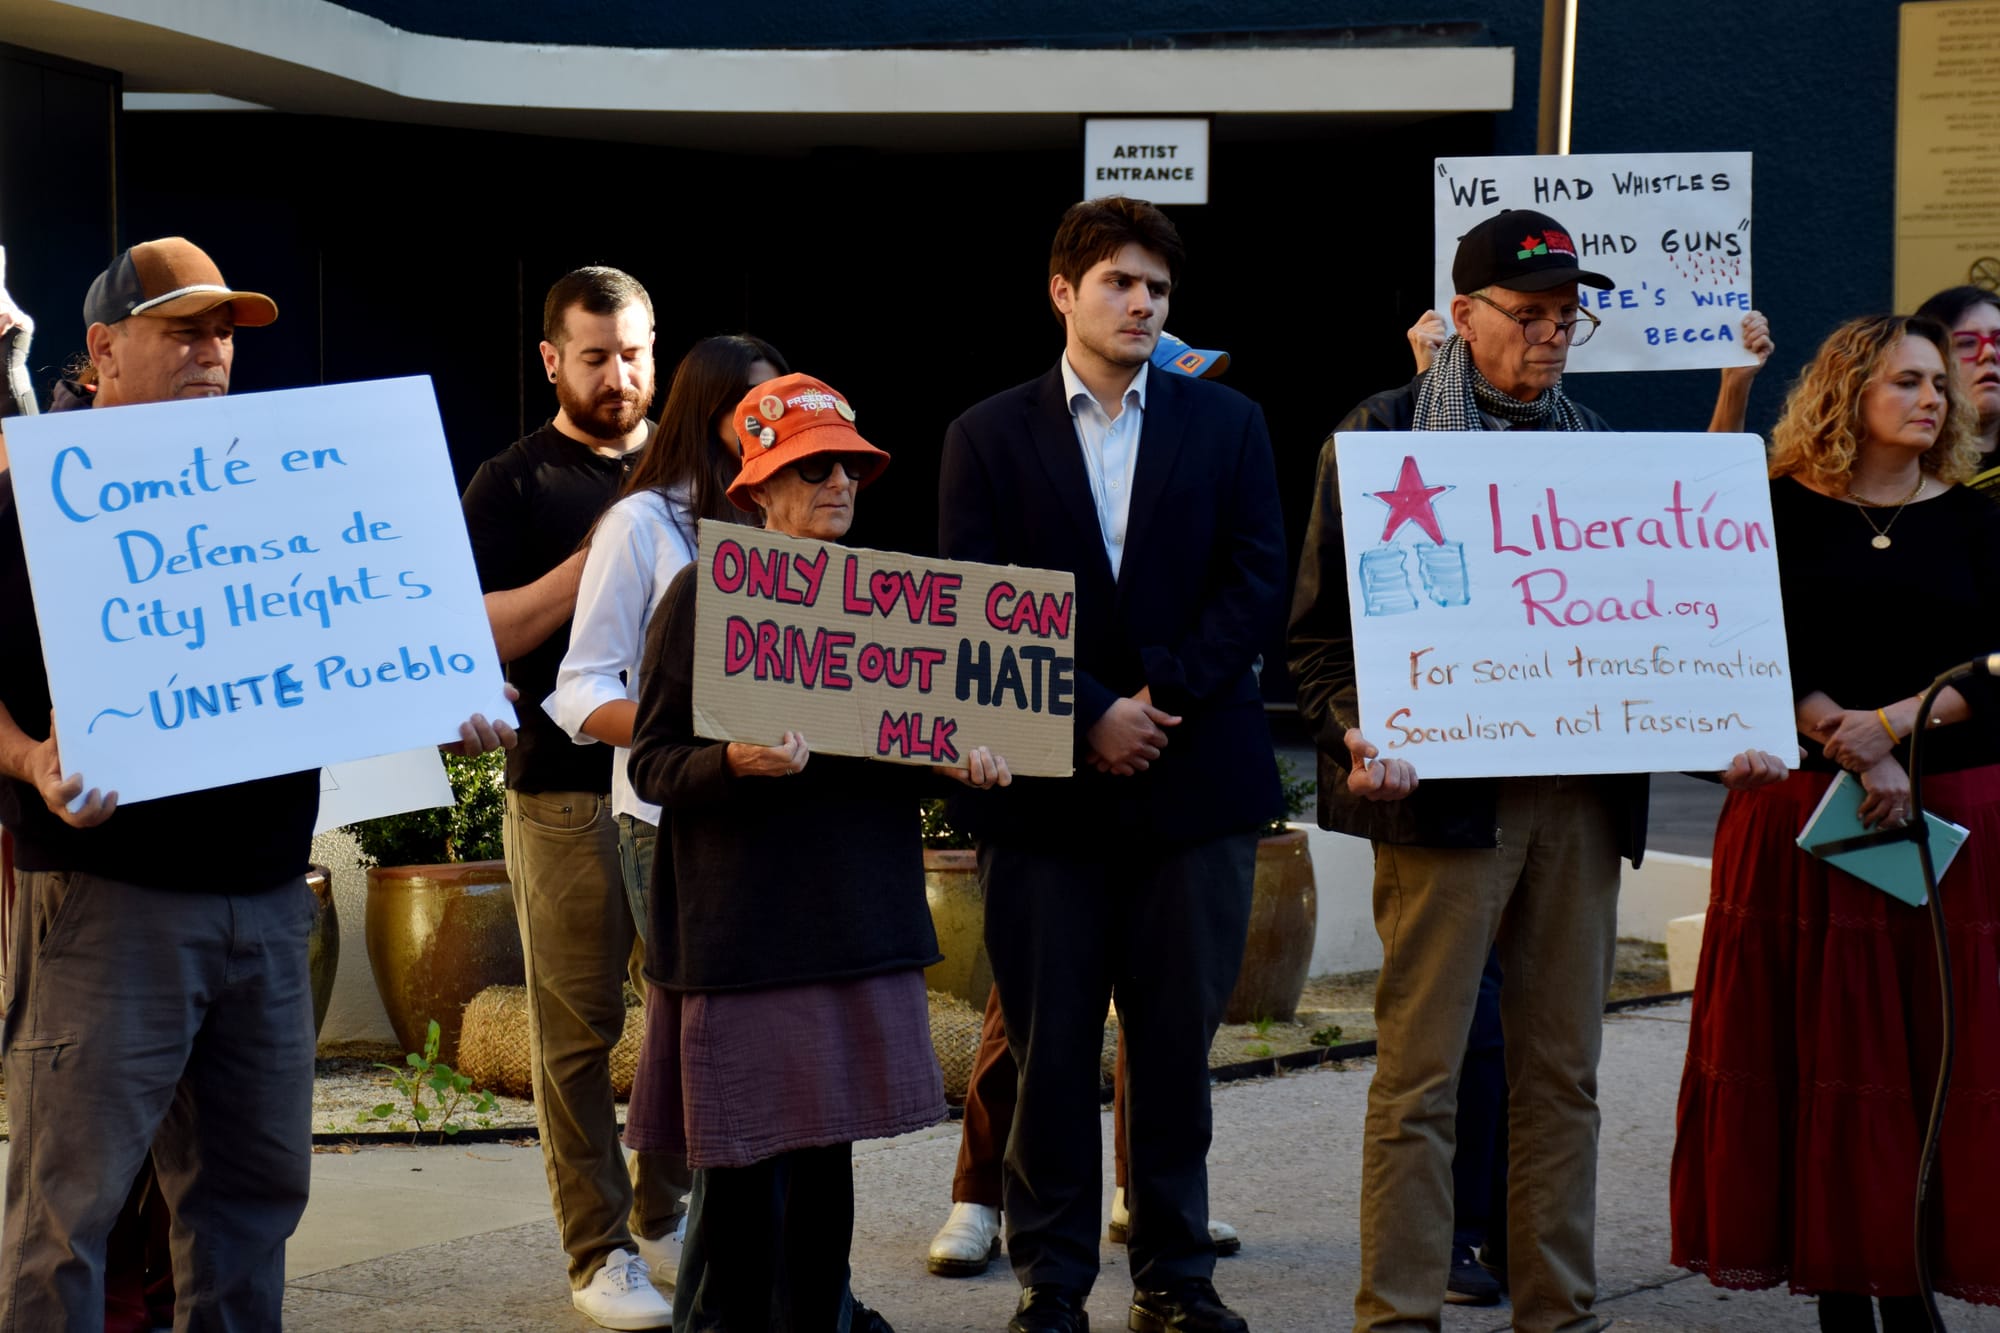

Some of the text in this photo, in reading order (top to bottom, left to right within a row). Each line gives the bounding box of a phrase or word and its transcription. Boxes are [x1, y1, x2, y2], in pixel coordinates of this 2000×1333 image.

[1096, 167, 1194, 181] ENTRANCE
[1113, 145, 1178, 159] ARTIST
[1534, 176, 1594, 203] HAD
[1612, 171, 1731, 197] WHISTLES
[1581, 232, 1637, 256] HAD
[1577, 281, 1750, 311] NEE'S WIFE
[1644, 323, 1734, 346] BECCA
[800, 401, 834, 411] TO BE
[51, 437, 348, 523] Comité en
[1488, 480, 1770, 556] Liberation
[114, 511, 403, 584] Defensa de
[712, 538, 829, 607] ONLY
[985, 580, 1074, 639] CAN
[1511, 568, 1720, 629] Road.org
[101, 597, 206, 650] City
[314, 645, 476, 691] Pueblo
[724, 615, 1074, 716] DRIVE OUT HATE
[1409, 645, 1783, 691] For social transformation
[877, 709, 960, 763] MLK
[1385, 700, 1754, 749] Socialism not Fascism
